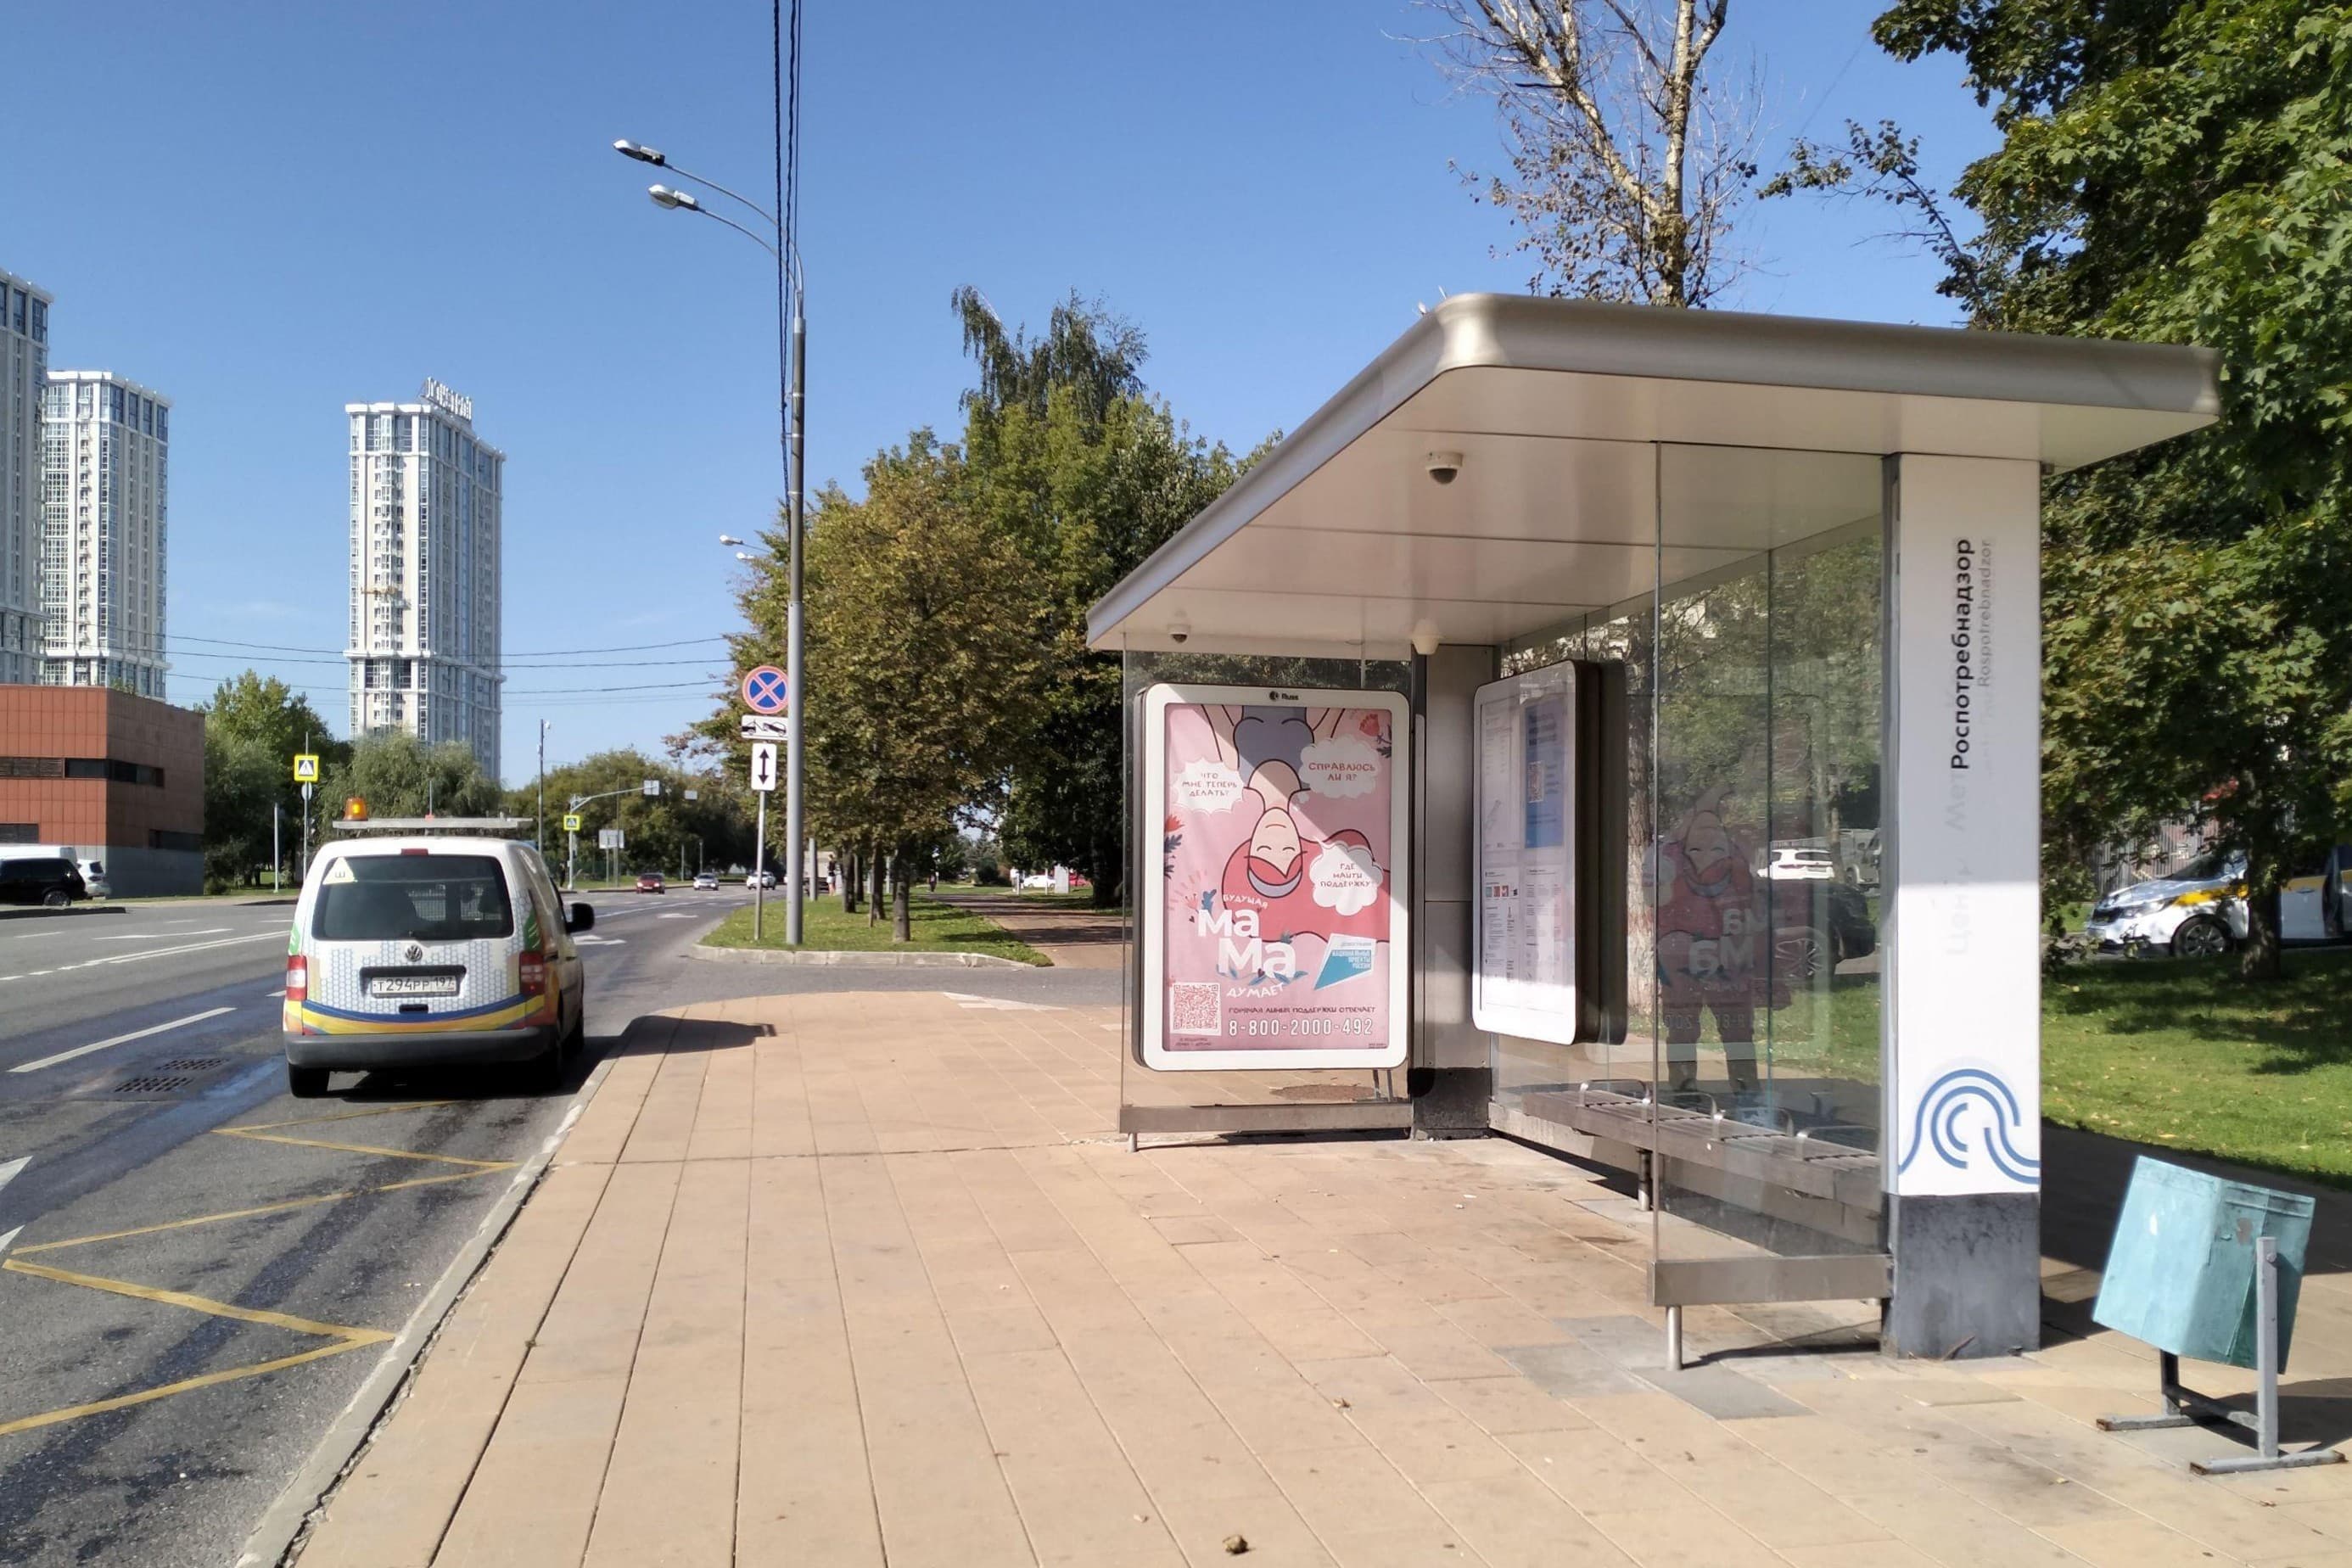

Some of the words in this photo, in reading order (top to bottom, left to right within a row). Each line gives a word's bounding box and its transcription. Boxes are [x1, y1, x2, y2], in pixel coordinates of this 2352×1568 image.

[1977, 540, 1992, 687] Rospotrebnadzor
[1951, 539, 1975, 770] Роспотребнадзор
[1308, 762, 1375, 771] СПРАВЛЮСЬ
[1223, 893, 1268, 909] БУДУЩАЯ
[434, 977, 453, 987] 197
[1226, 983, 1285, 998] ДУМАЕТ
[1229, 1018, 1373, 1036] 8-800-2000-492
